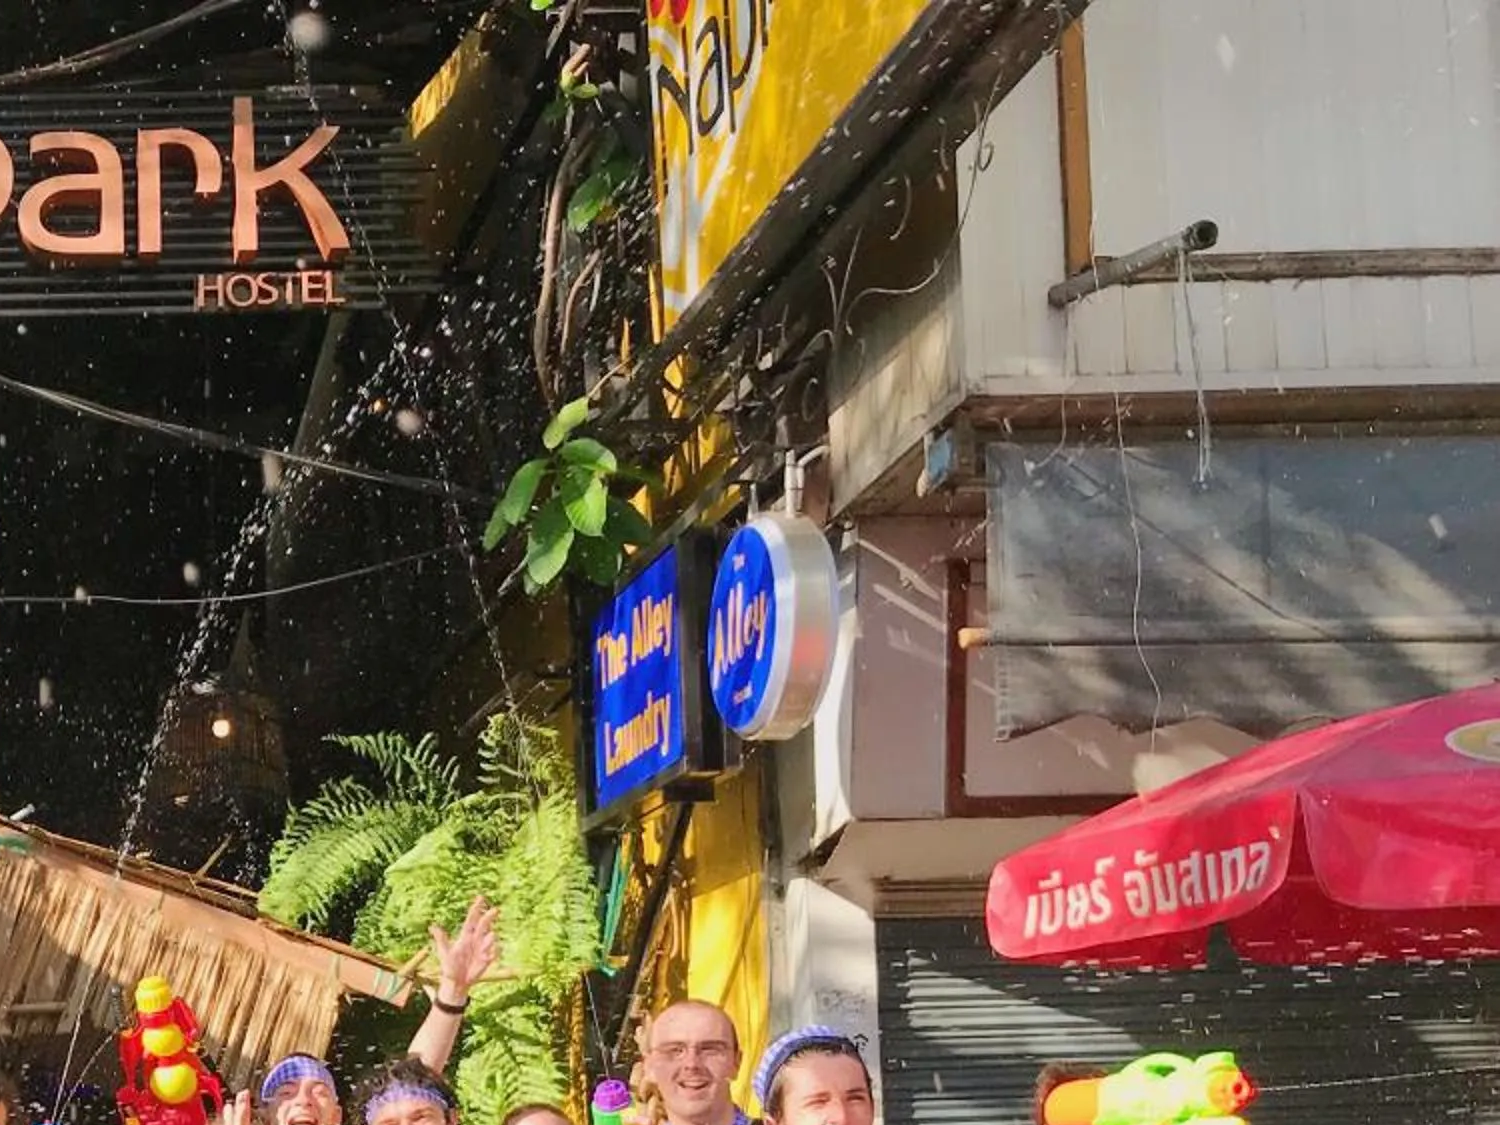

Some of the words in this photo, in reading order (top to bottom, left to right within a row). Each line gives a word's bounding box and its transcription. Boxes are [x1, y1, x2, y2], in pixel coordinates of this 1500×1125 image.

[194, 271, 346, 310] HOSTEL
[597, 631, 628, 690] The
[631, 593, 673, 667] Alley
[712, 581, 769, 691] Alley
[604, 690, 671, 777] Laundry
